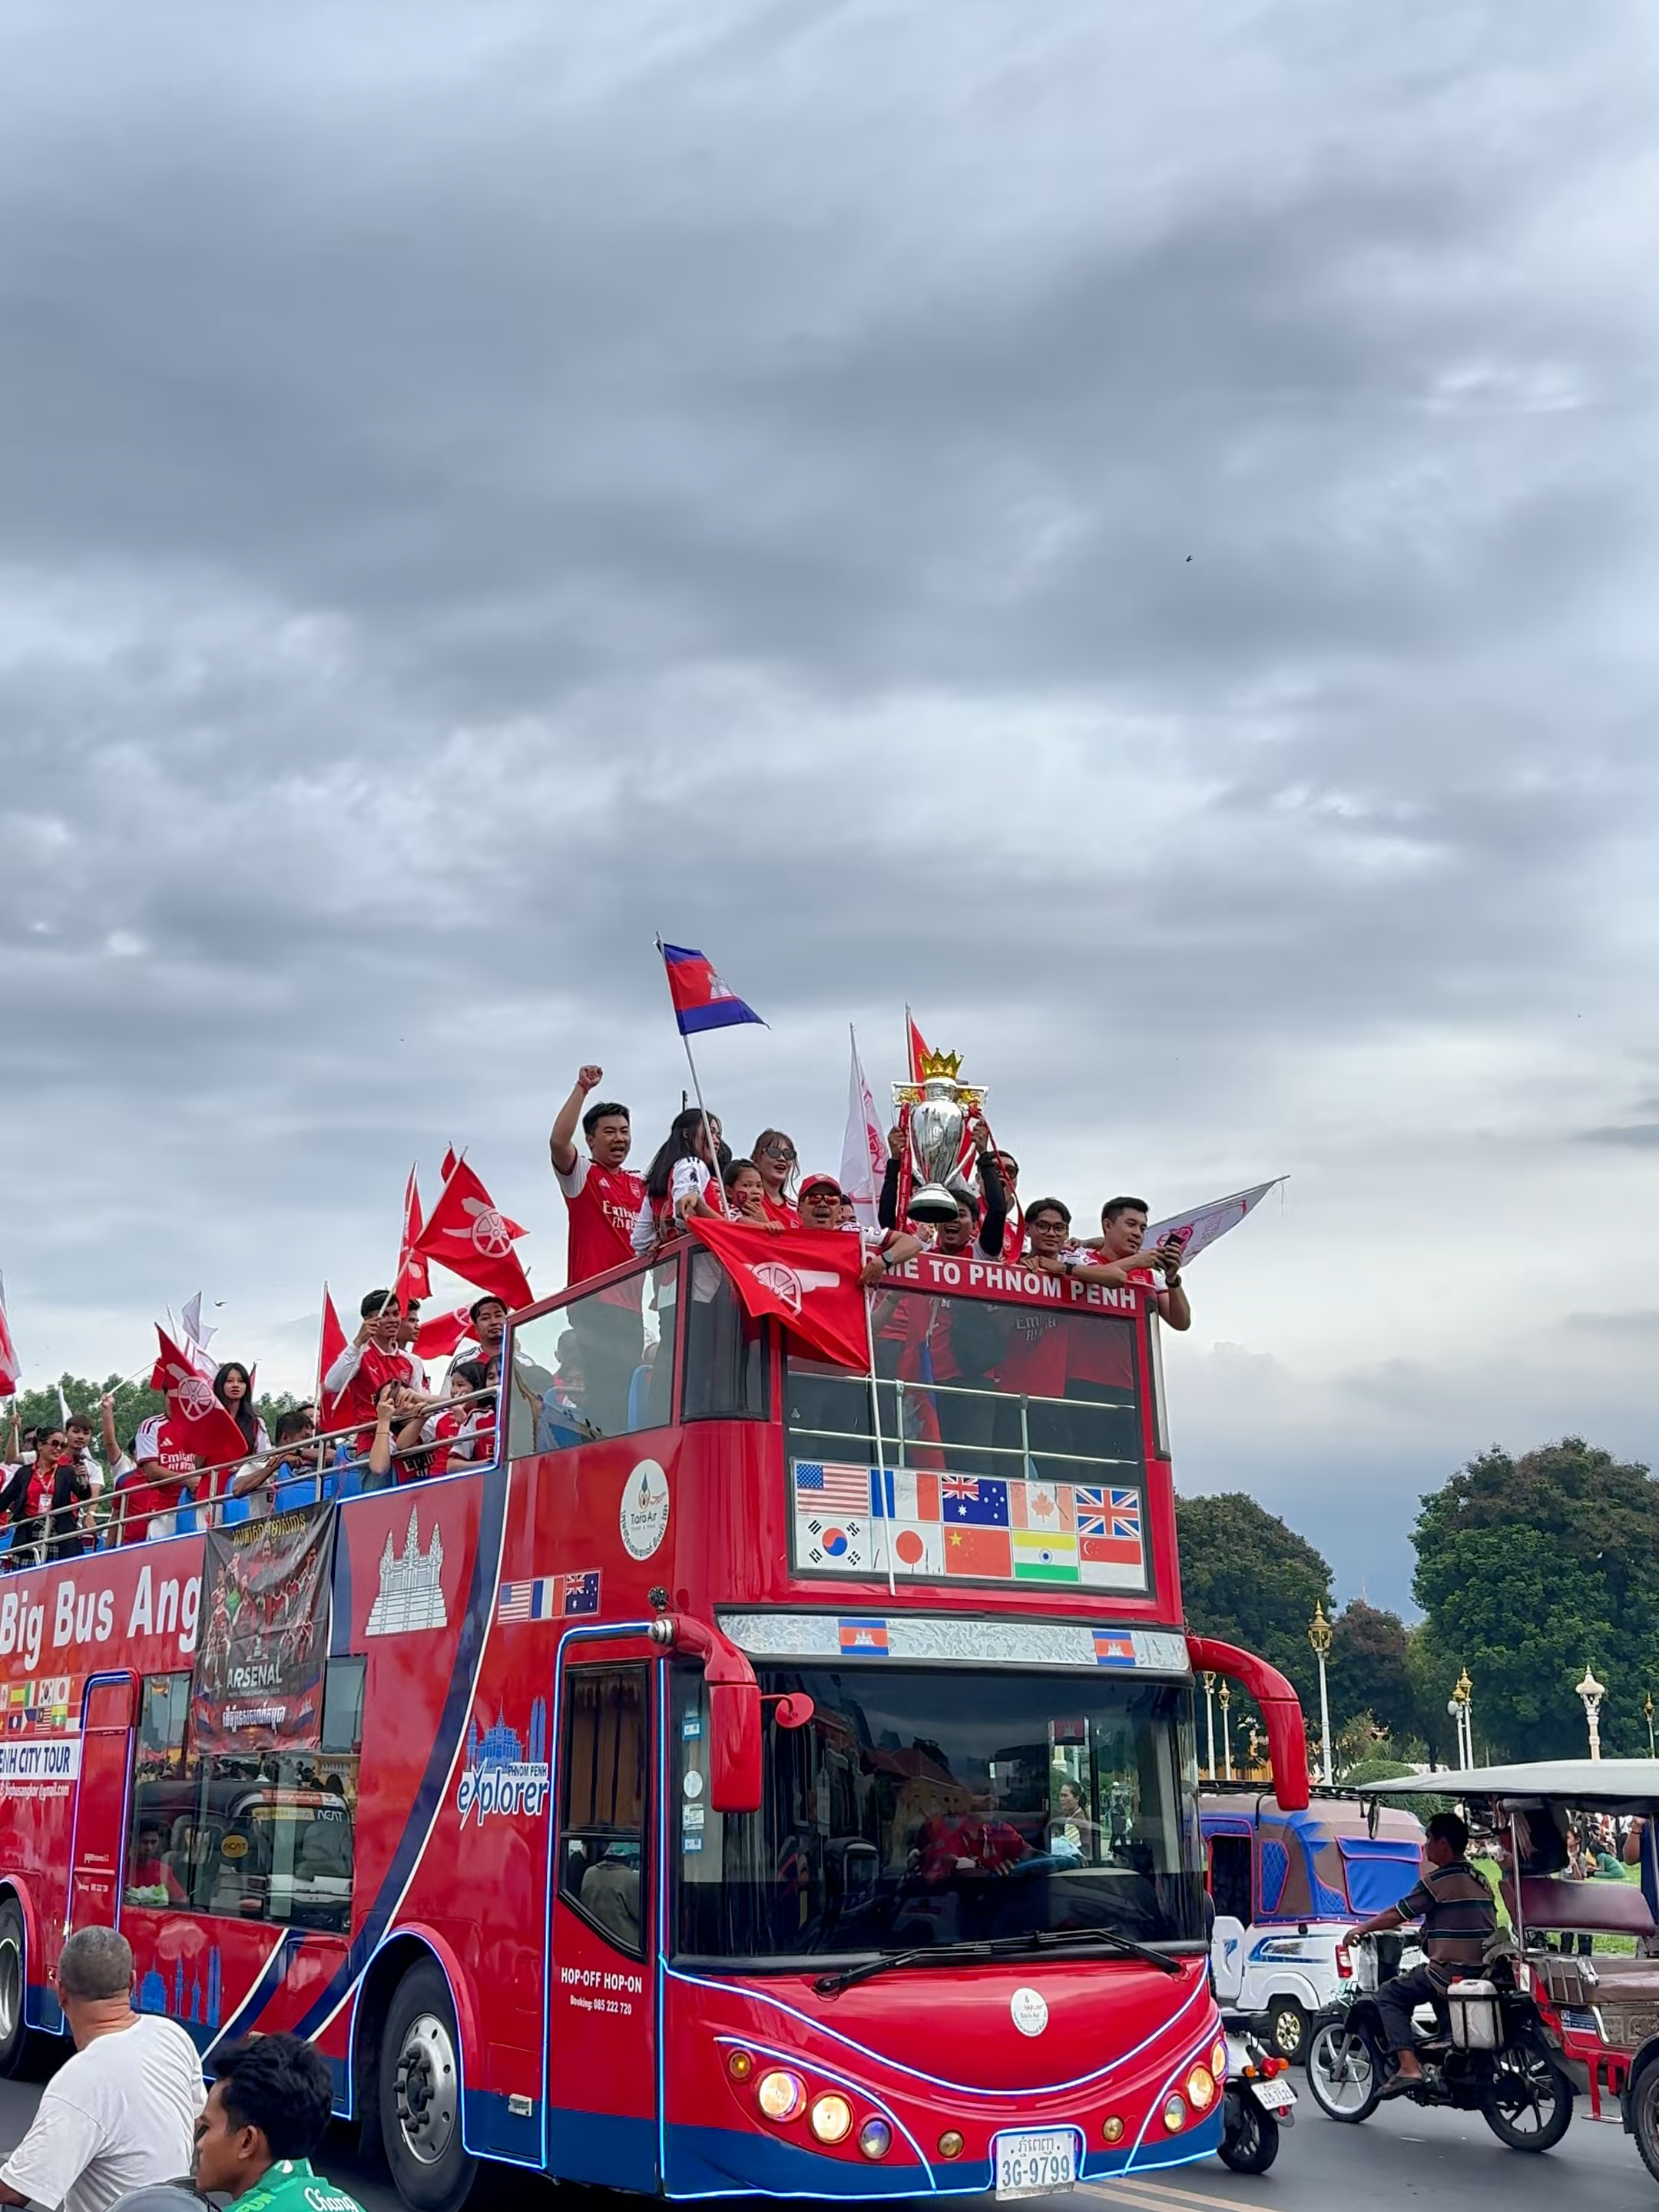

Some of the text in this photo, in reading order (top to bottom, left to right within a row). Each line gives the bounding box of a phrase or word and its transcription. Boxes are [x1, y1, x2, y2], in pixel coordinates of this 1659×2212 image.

[929, 1260, 961, 1285] TO
[969, 1263, 1061, 1299] PHNOM
[1070, 1280, 1136, 1310] PENH
[0, 1590, 45, 1671] Big
[53, 1580, 114, 1648] Bus
[227, 1662, 283, 1689] ARSENAL
[19, 1747, 42, 1773] CITY
[44, 1746, 70, 1773] TOUR
[593, 1998, 605, 2011] 085
[606, 2000, 619, 2013] 222
[620, 2002, 632, 2015] 720
[1002, 2155, 1070, 2187] 3G-9799
